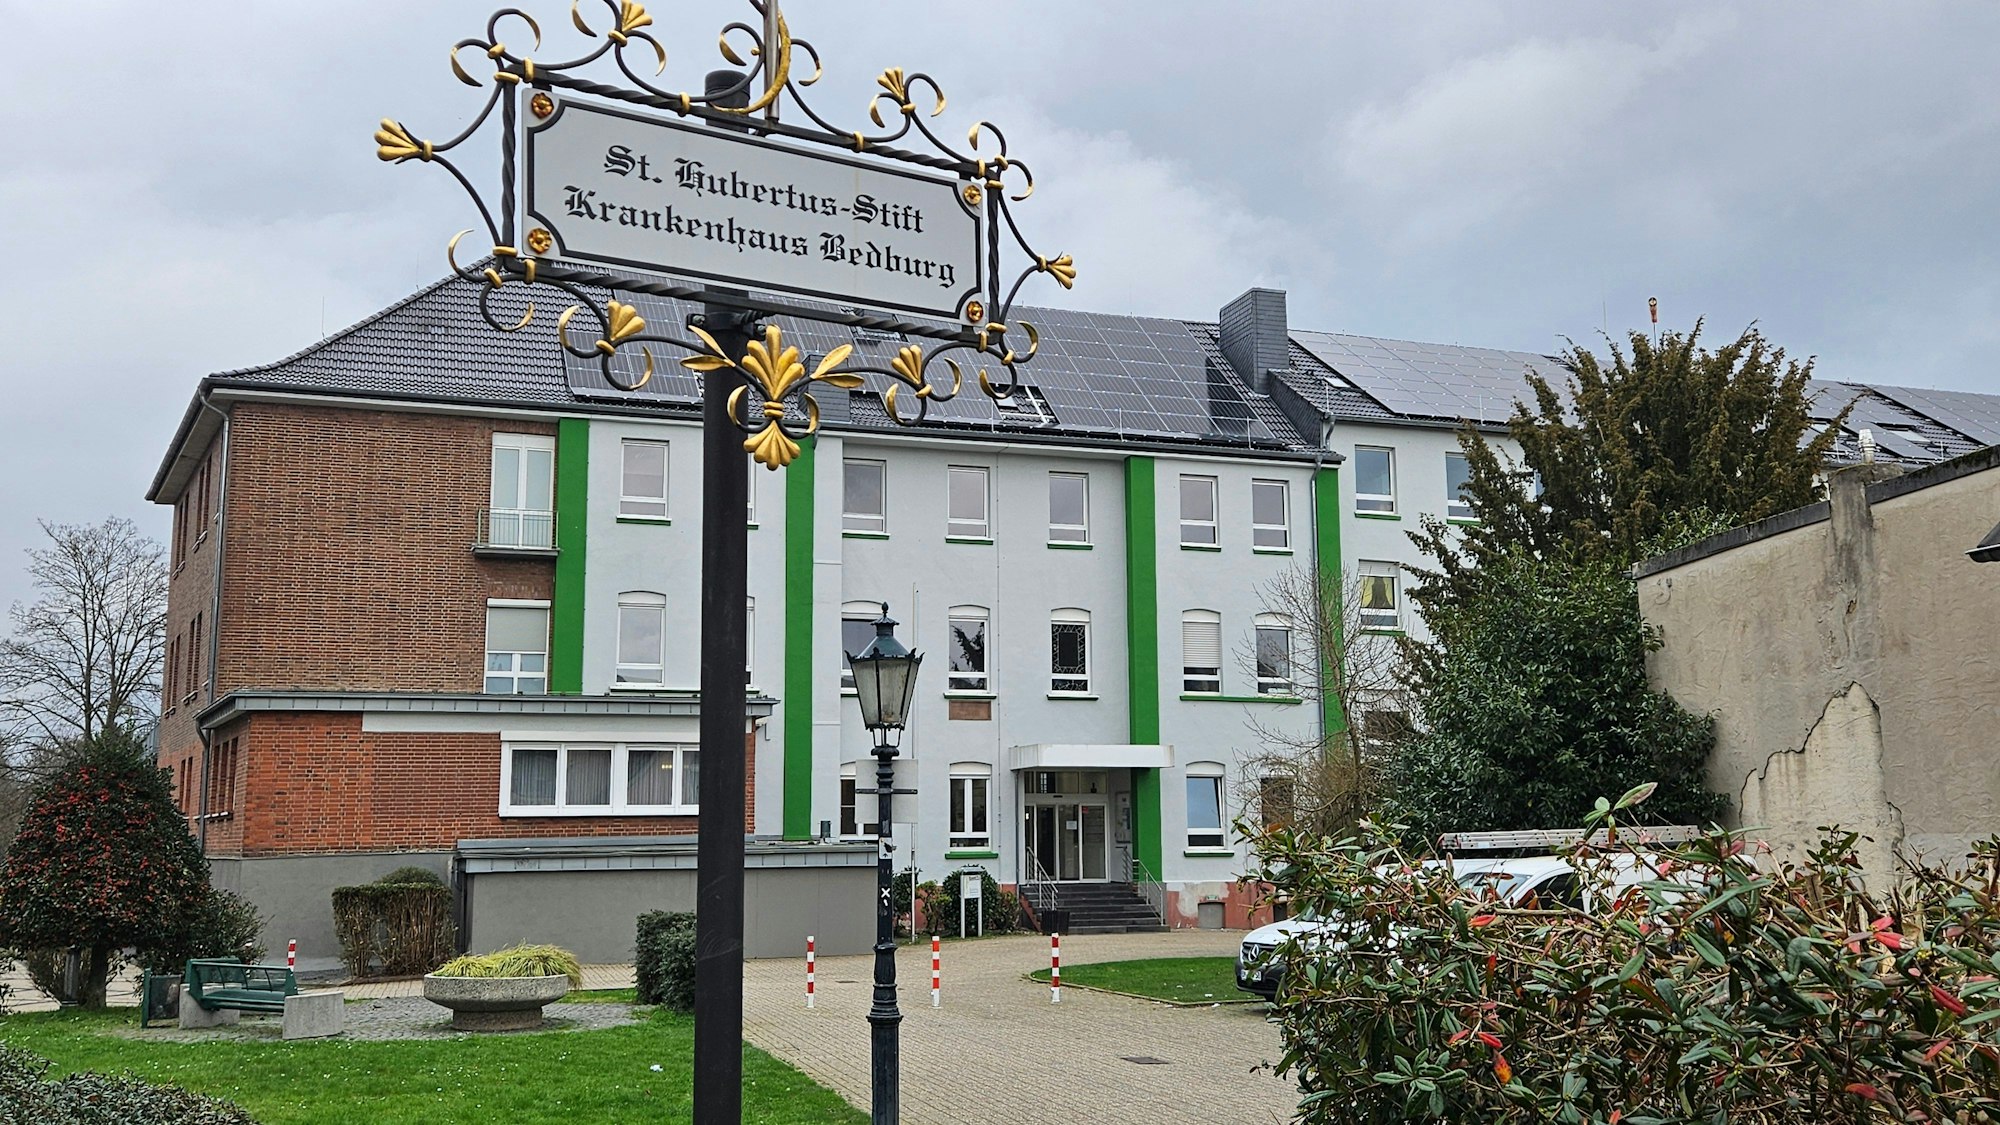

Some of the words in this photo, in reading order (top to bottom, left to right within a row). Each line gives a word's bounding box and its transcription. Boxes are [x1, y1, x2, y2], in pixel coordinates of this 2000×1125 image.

[564, 185, 809, 257] Krankenhaus
[819, 232, 956, 289] Bedburg
[604, 144, 663, 184] St.
[674, 157, 925, 234] Hubertus-Stift
